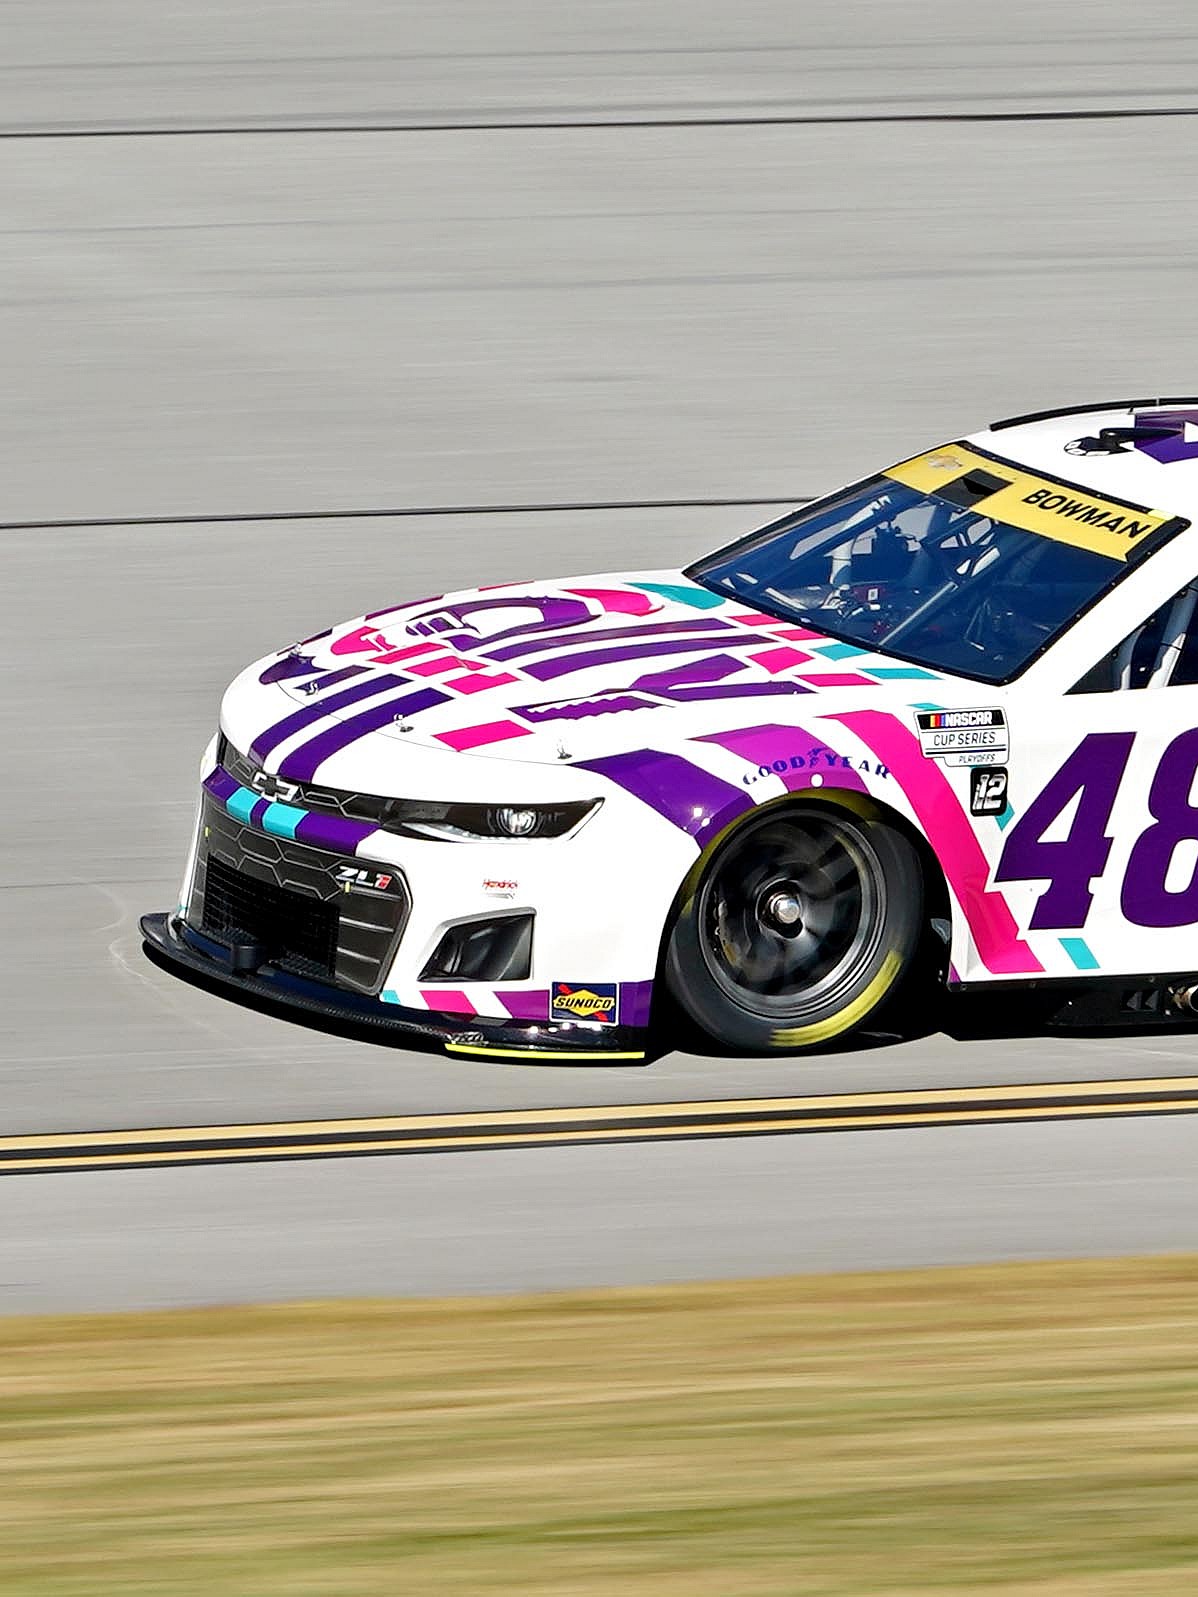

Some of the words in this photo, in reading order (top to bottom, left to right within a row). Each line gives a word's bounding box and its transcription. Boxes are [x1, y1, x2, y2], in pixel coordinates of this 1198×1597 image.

[1021, 488, 1151, 539] BOWMAN
[945, 711, 993, 728] NASCAR
[933, 734, 956, 746] CUP
[957, 731, 996, 745] SERIES
[335, 865, 393, 891] ZL1
[555, 996, 613, 1010] SUNOCO
